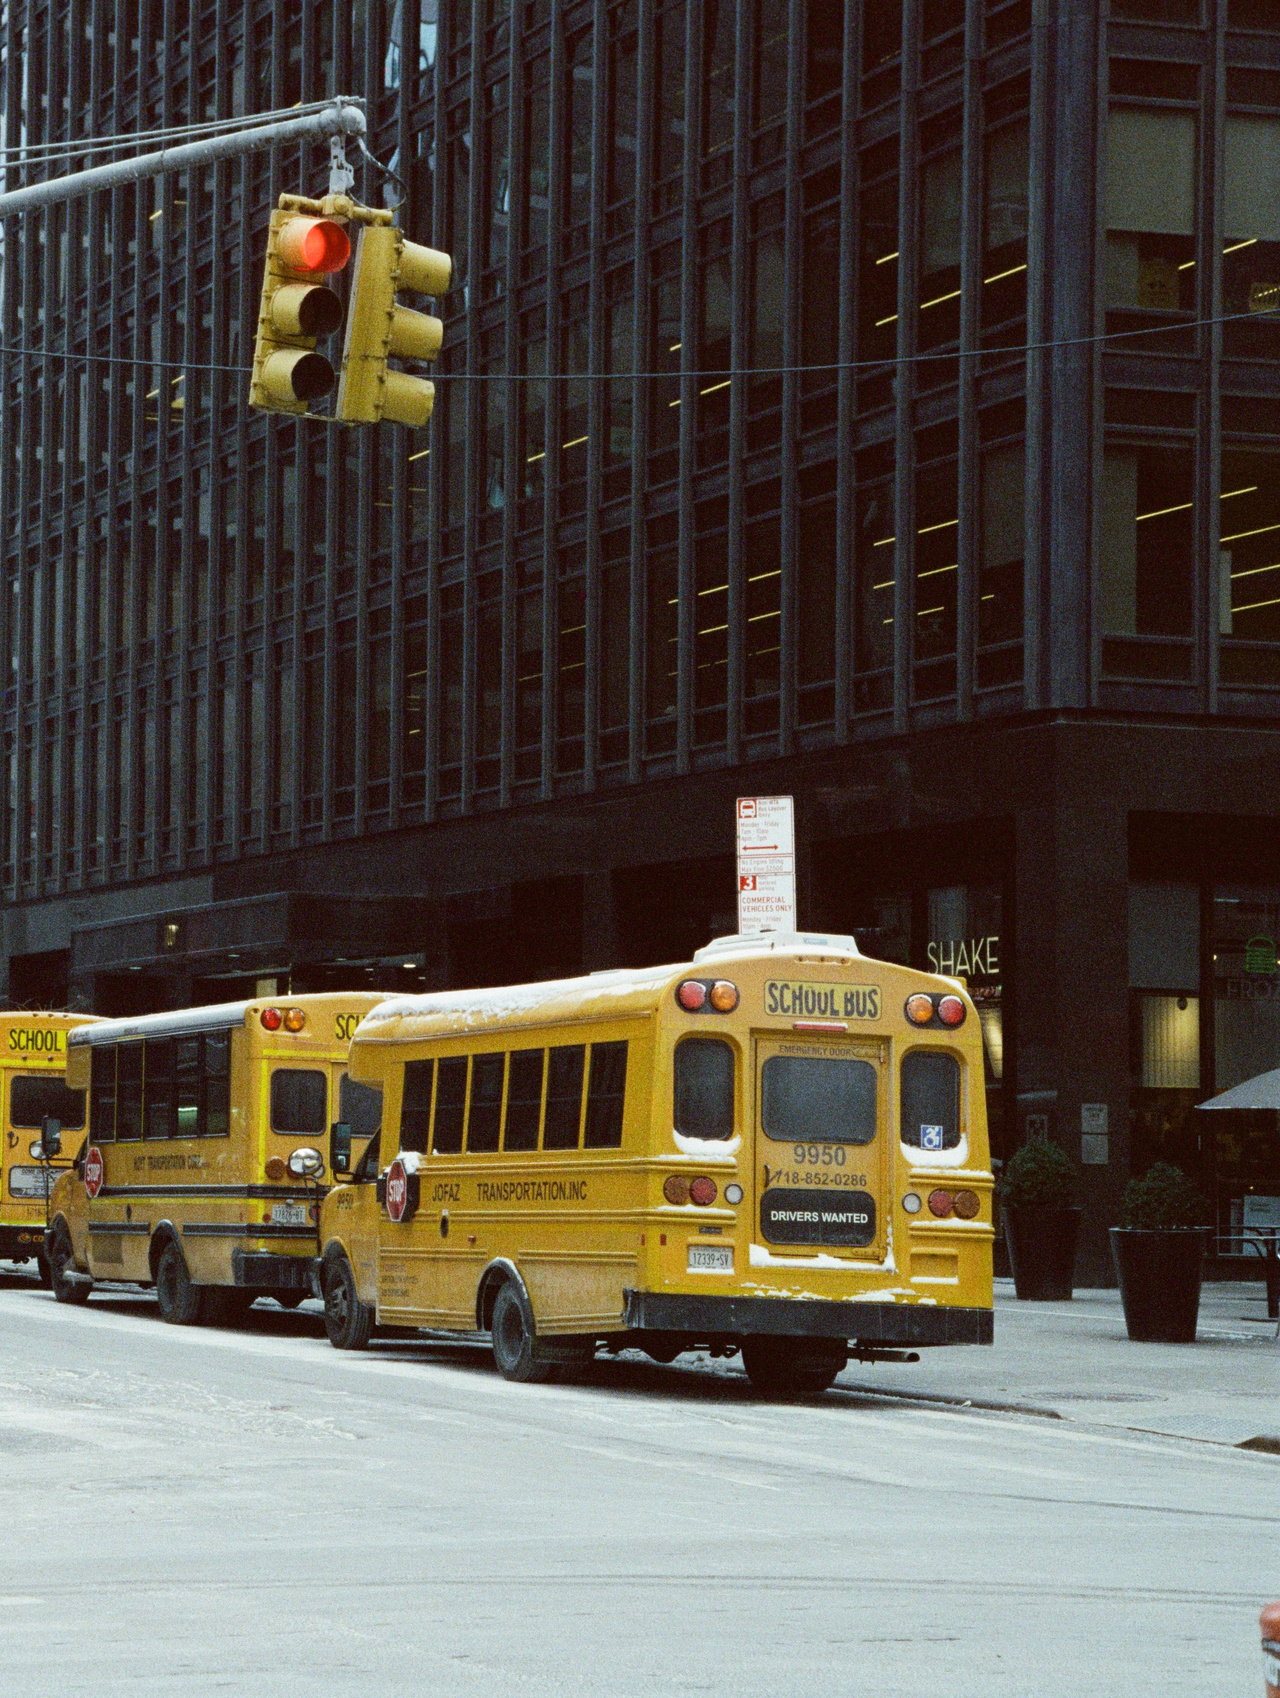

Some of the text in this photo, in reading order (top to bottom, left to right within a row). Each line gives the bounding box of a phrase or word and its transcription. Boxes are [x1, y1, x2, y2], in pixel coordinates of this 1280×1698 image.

[743, 874, 754, 890] 3
[742, 896, 786, 904] COMMERCIAL
[927, 936, 1000, 976] SHAKE
[767, 982, 879, 1018] SCHOOL BUS
[9, 1028, 62, 1052] SCHOOL
[779, 1044, 852, 1056] EMERGENCY DOOR
[793, 1144, 847, 1167] 9950
[86, 1163, 101, 1181] STOP
[389, 1179, 405, 1202] STOP
[432, 1183, 461, 1202] JOFAZ
[770, 1210, 869, 1224] DRIVERS WANTED
